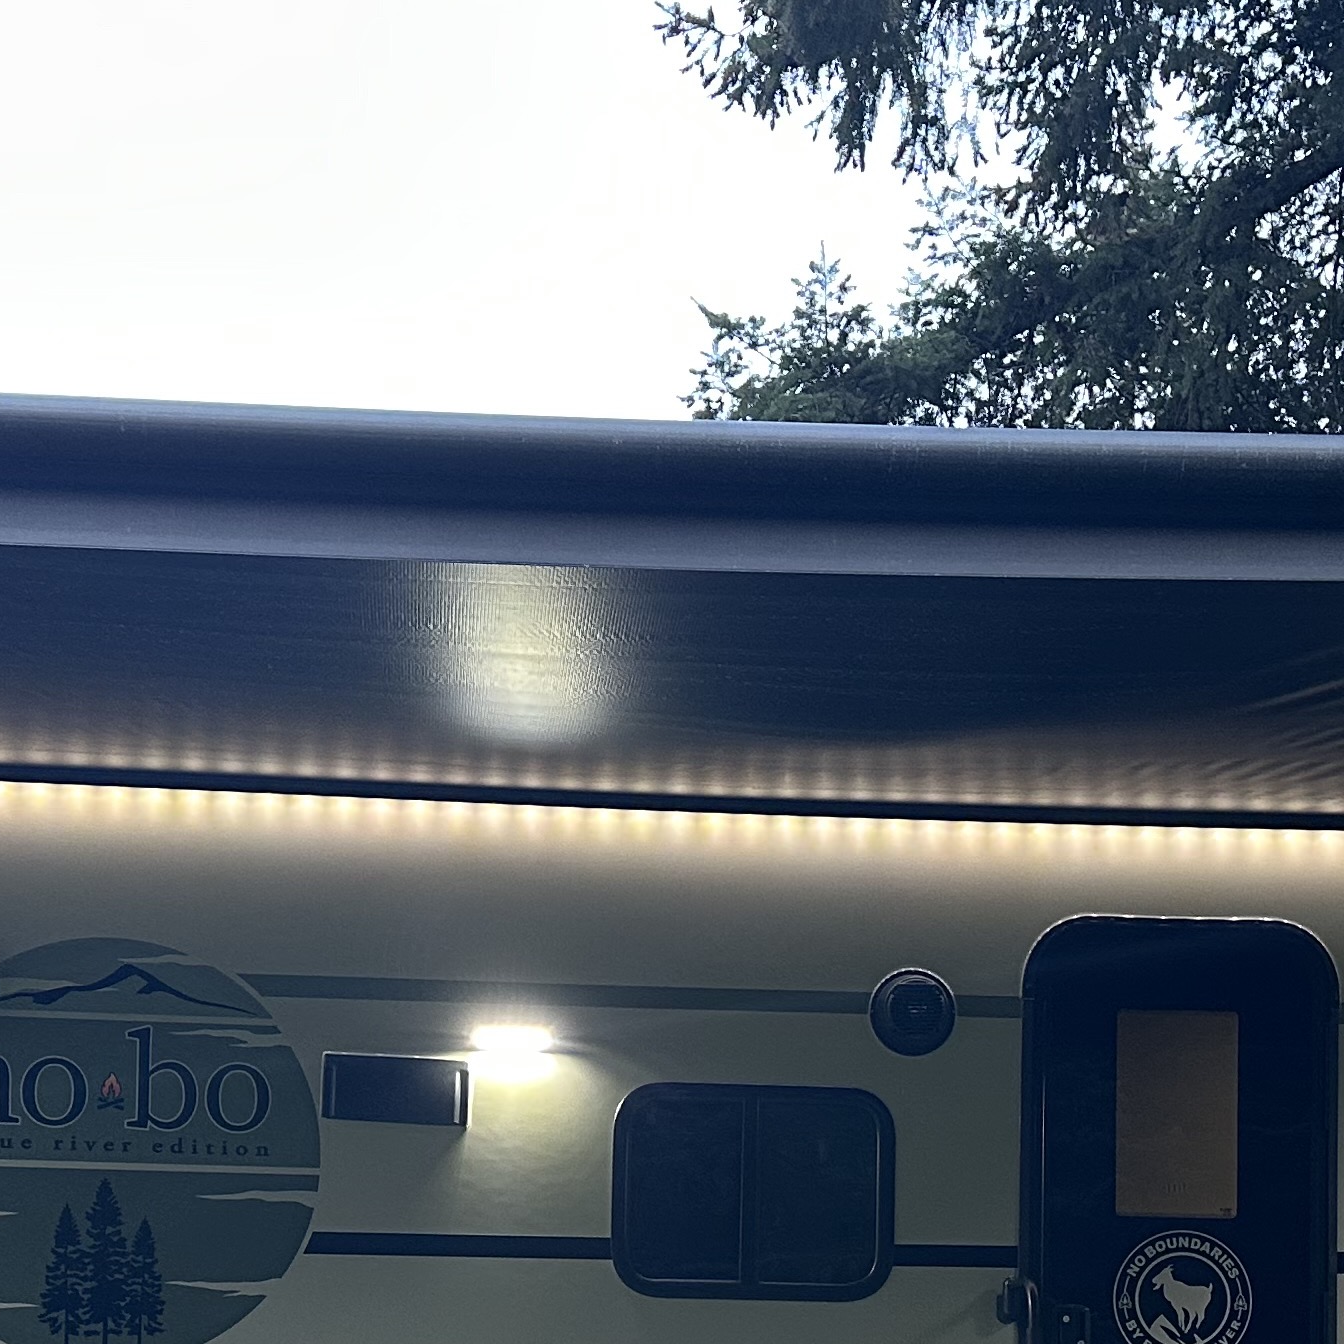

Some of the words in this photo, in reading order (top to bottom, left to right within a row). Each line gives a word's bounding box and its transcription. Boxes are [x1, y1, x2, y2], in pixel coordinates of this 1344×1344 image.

[52, 1135, 134, 1154] river
[151, 1136, 271, 1158] edition
[1127, 1254, 1146, 1278] NO
[1144, 1236, 1240, 1280] BOUNDARIES
[1125, 1319, 1145, 1340] BY
